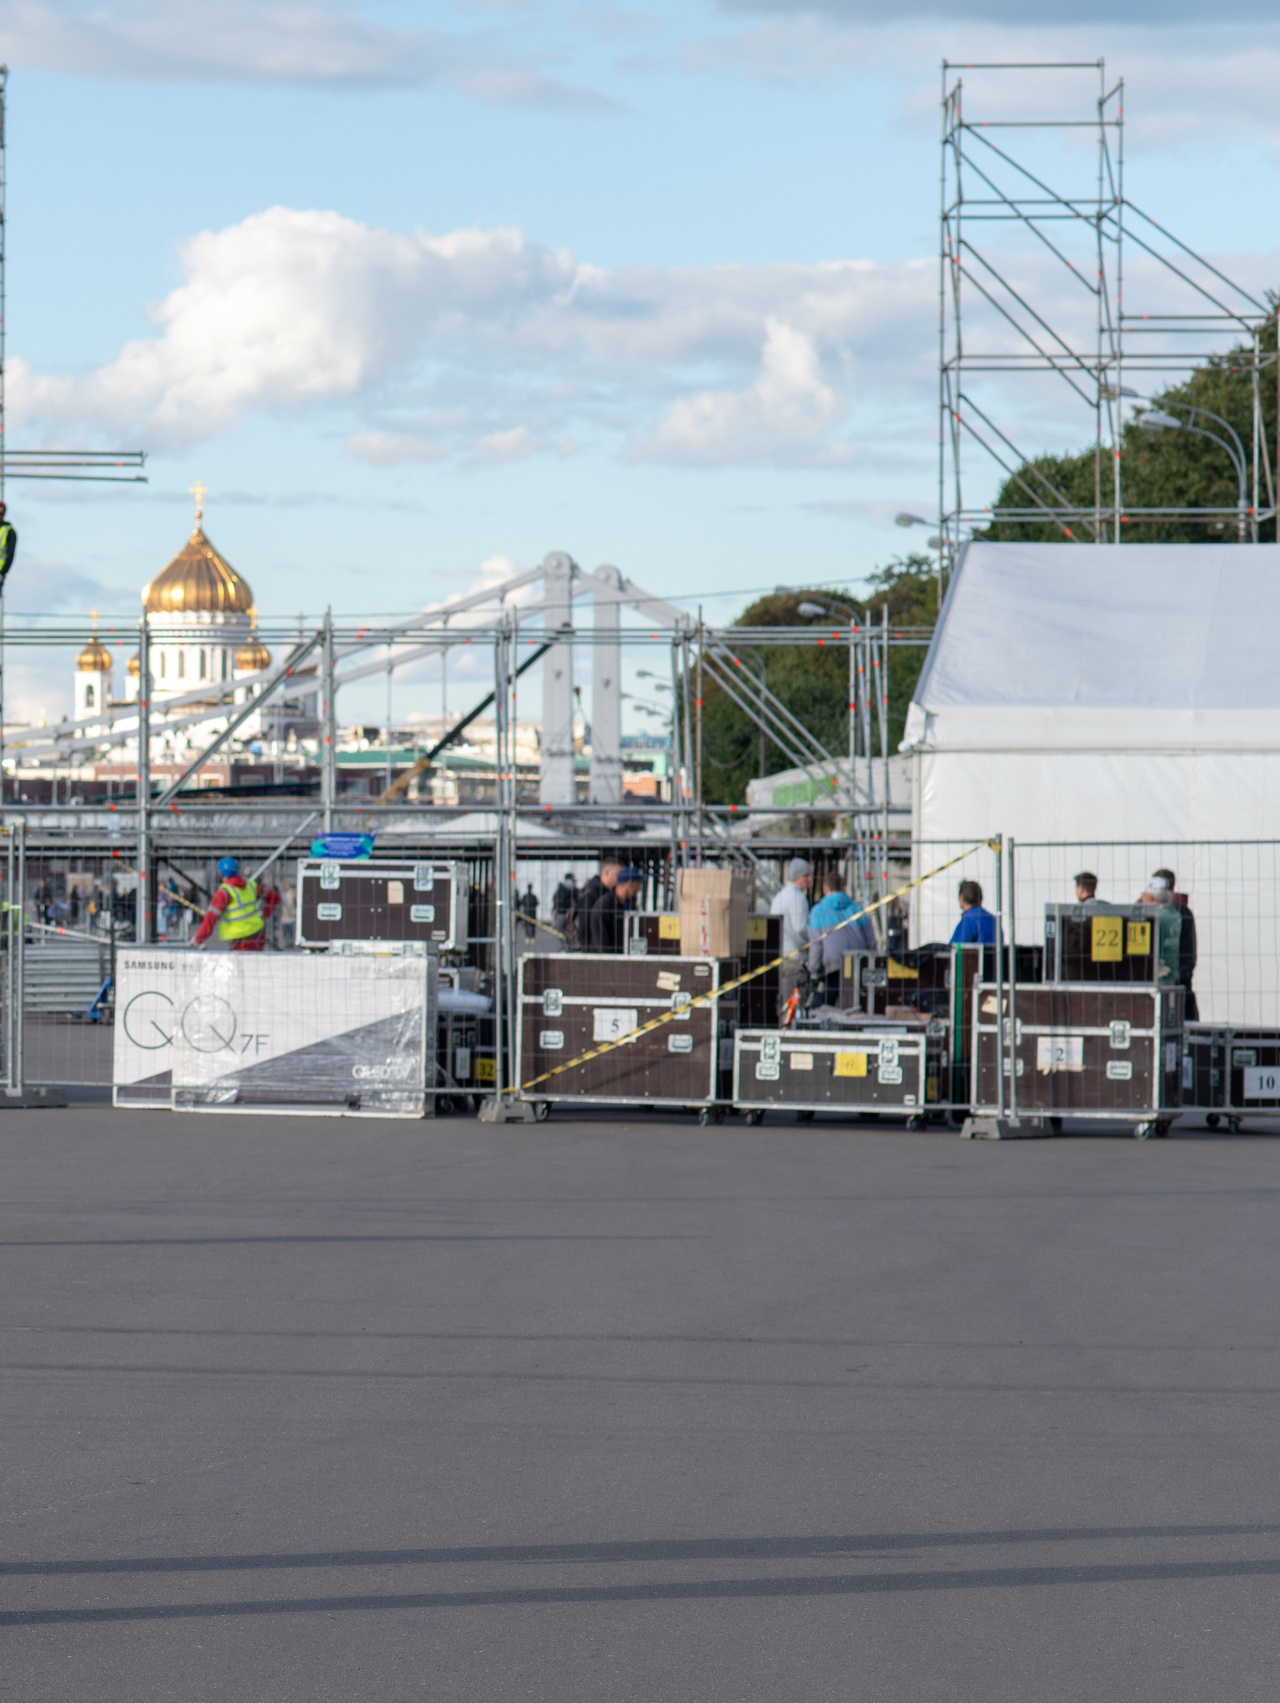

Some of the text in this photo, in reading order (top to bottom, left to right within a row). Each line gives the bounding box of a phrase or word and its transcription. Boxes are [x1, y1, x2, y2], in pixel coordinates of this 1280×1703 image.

[1096, 929, 1120, 947] 22
[123, 960, 175, 971] SAMSUNG
[611, 1018, 620, 1033] 5
[1055, 1047, 1065, 1062] 2
[479, 1063, 494, 1078] 32
[1260, 1075, 1275, 1090] 10
